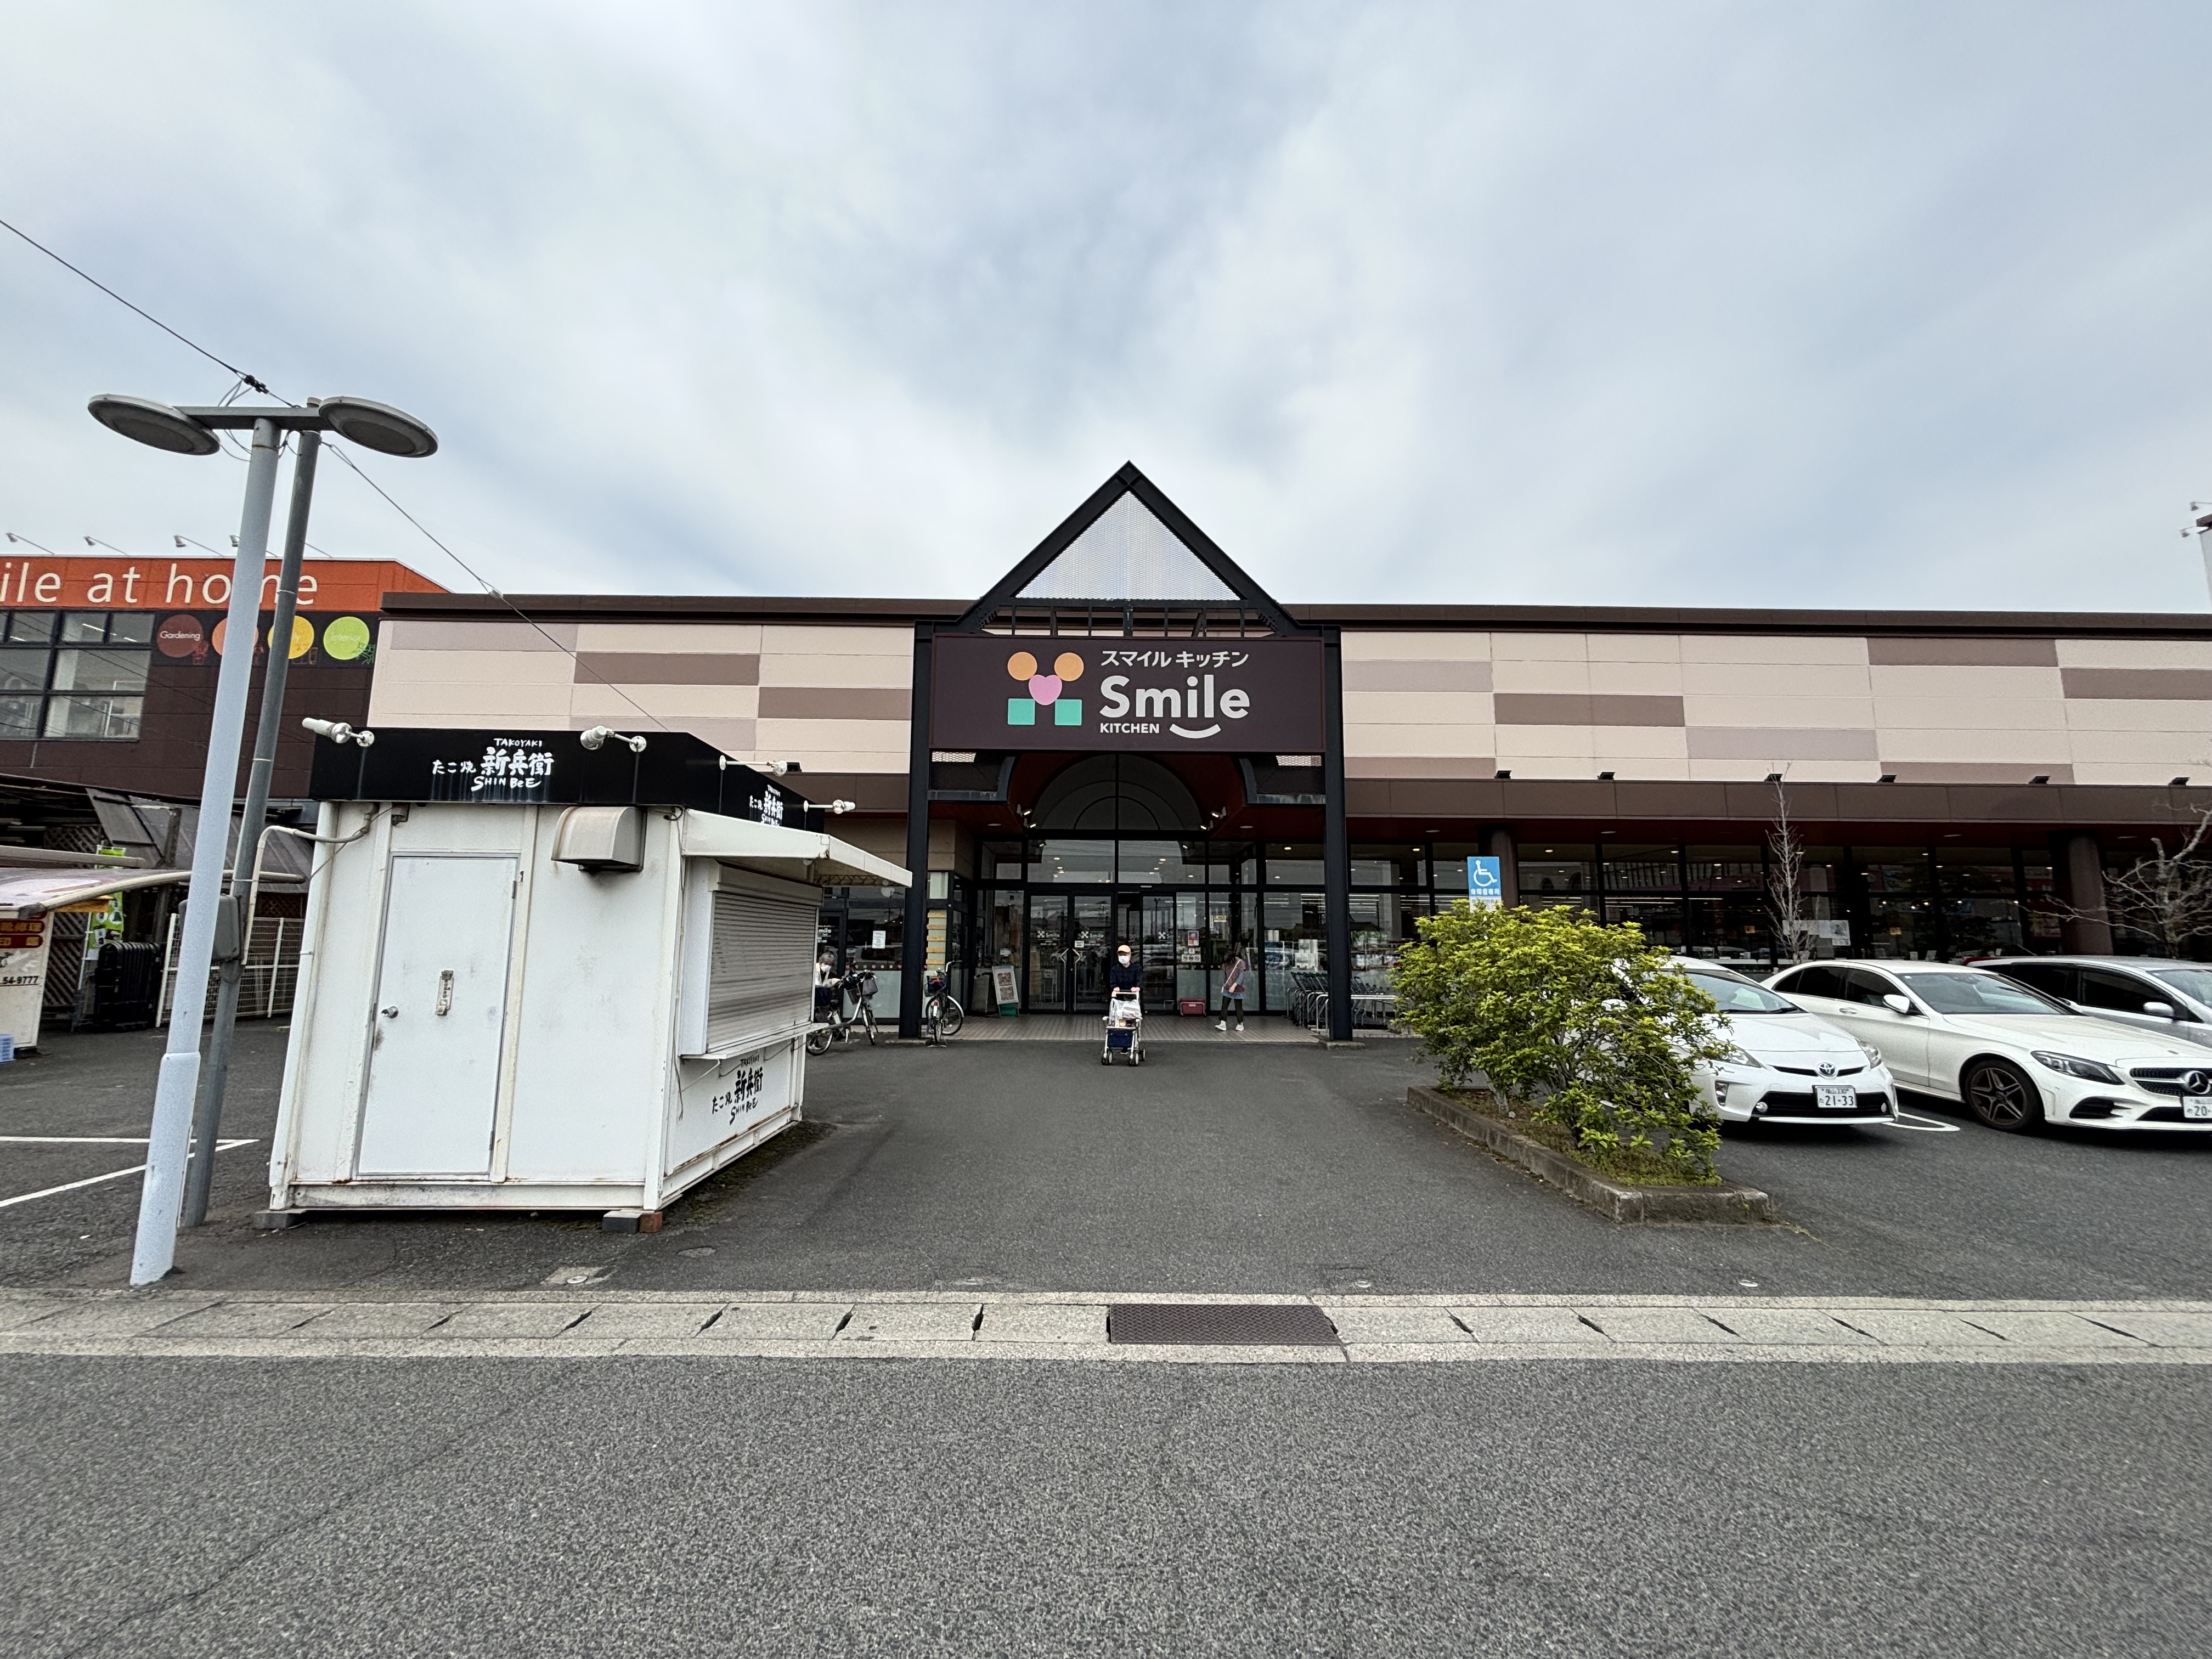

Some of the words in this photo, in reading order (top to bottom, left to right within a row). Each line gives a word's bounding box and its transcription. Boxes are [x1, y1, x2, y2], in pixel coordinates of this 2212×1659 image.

[87, 566, 140, 603] at
[160, 631, 200, 641] Gardening
[1101, 651, 1172, 667] スマイル
[1175, 651, 1249, 668] キッチン
[1099, 675, 1250, 718] Smile
[1100, 723, 1160, 733] KITCHEN
[493, 738, 543, 747] TAKOYAKI
[432, 759, 477, 775] たこ焼
[481, 747, 554, 776] 新兵衛
[471, 776, 506, 792] SHIN
[734, 1066, 763, 1103] 新兵衛
[1825, 1095, 1854, 1106] 21-33
